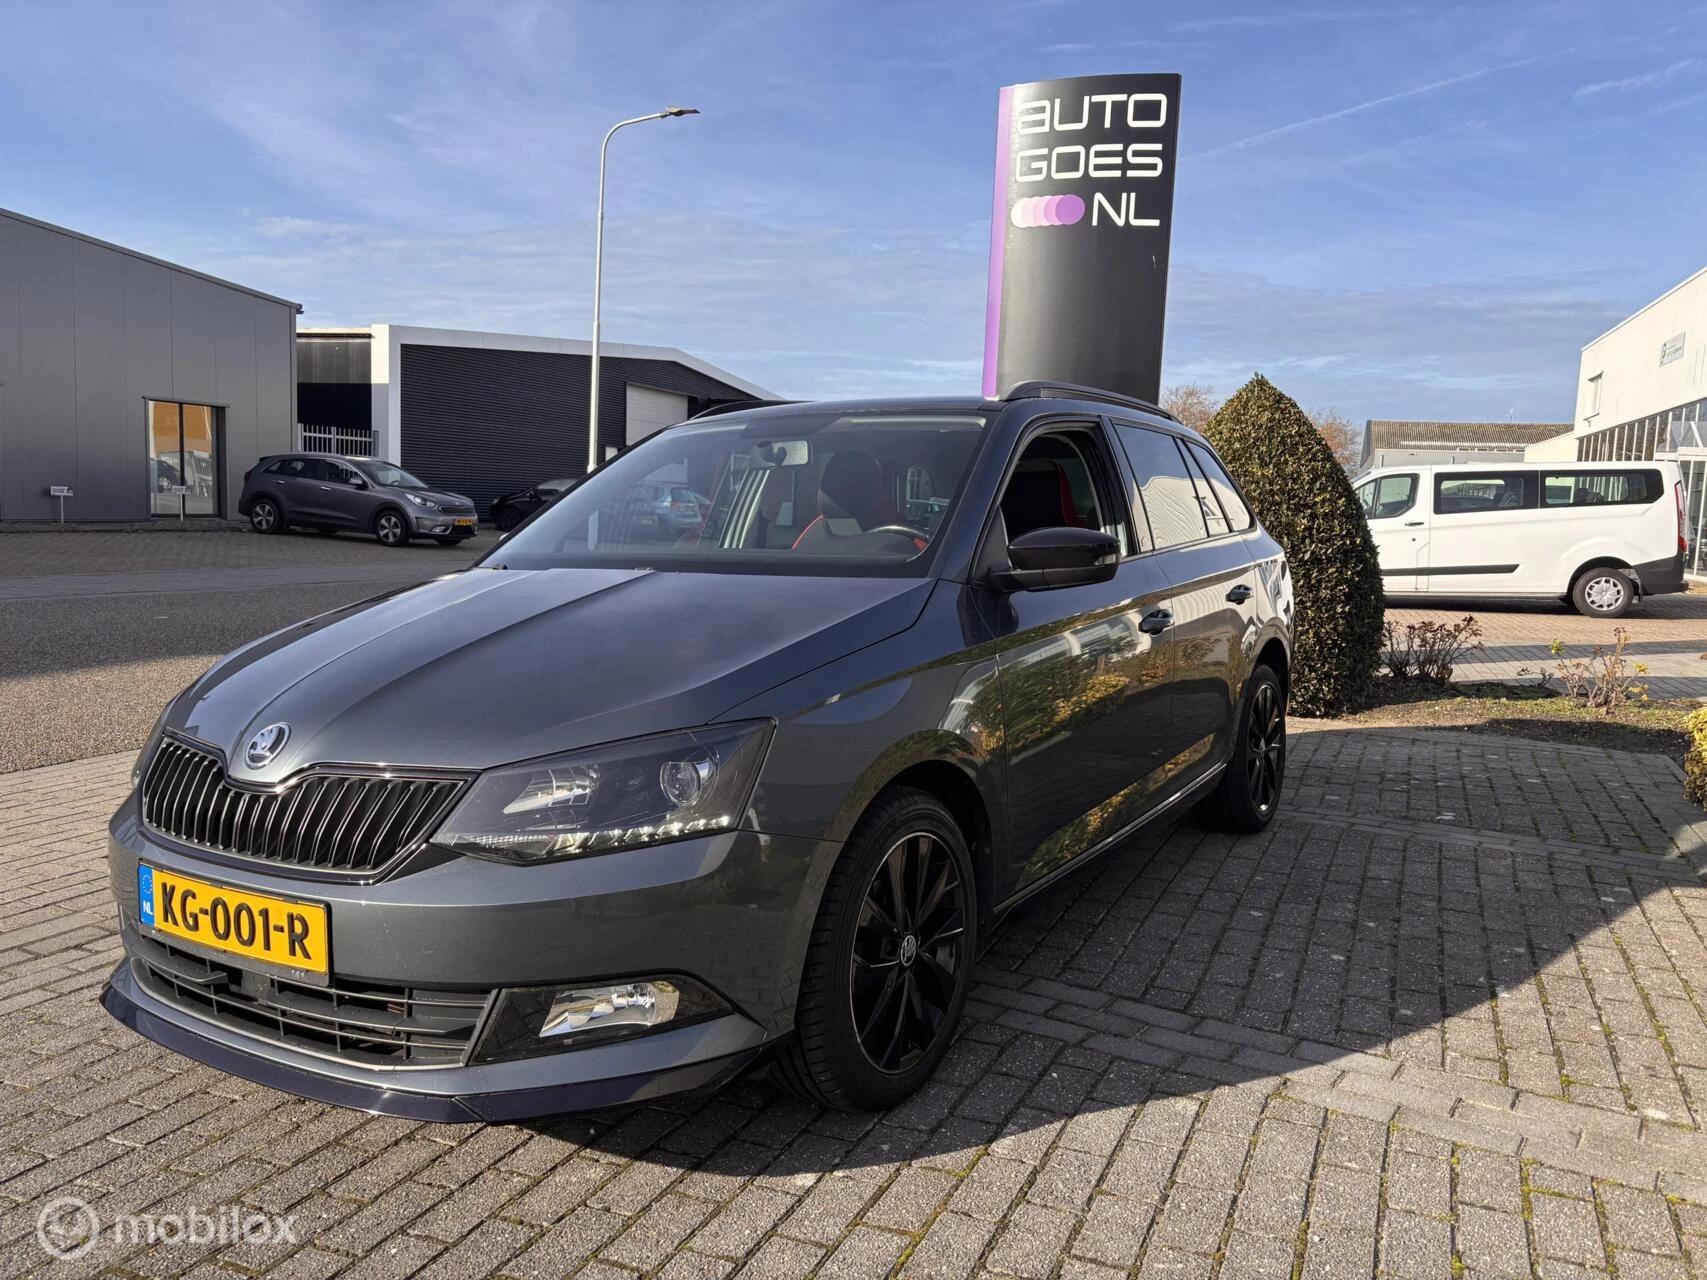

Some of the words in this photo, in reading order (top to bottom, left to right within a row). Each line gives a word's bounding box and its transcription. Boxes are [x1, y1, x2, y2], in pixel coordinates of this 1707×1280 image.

[1016, 93, 1167, 134] AUTO
[1015, 143, 1162, 183] GOES
[1091, 192, 1160, 226] NL
[142, 900, 154, 915] NL
[161, 882, 312, 960] KG-001-R
